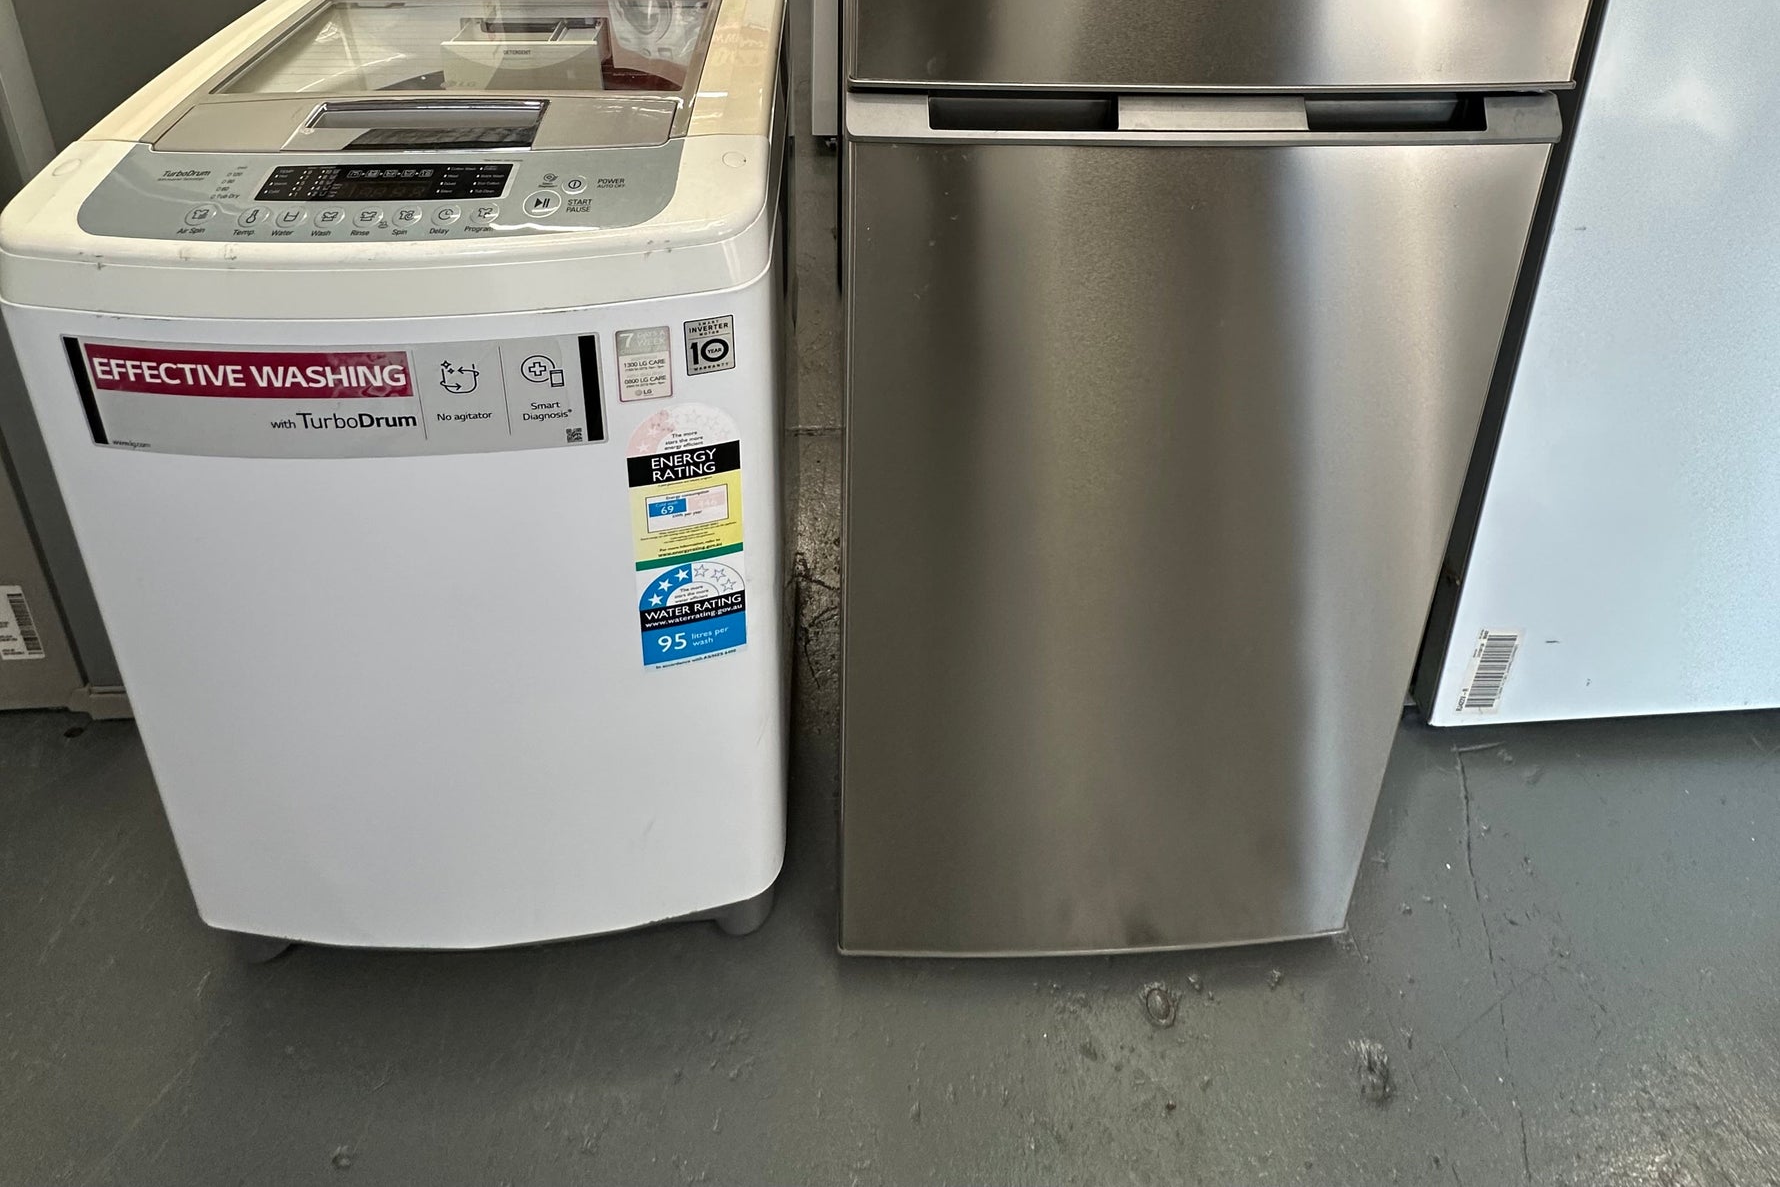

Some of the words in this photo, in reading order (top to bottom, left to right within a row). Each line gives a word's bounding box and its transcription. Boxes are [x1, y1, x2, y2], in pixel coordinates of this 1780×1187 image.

[163, 170, 211, 178] TurboDrum
[188, 227, 206, 235] Spin
[689, 323, 729, 333] INVERTER
[690, 338, 729, 365] 10
[92, 357, 246, 388] EFFECTIVE
[250, 364, 407, 389] WASHING
[530, 401, 561, 411] Smart
[270, 418, 296, 429] with
[296, 413, 417, 430] TurboDrum
[437, 413, 452, 421] No
[454, 411, 493, 422] agitator
[651, 448, 717, 470] ENERGY
[652, 461, 716, 482] RATING
[660, 505, 674, 515] 69
[645, 605, 691, 621] WATER
[694, 594, 742, 611] RATING
[645, 603, 743, 628] www.waterrating.gov.au
[691, 629, 712, 640] litres
[714, 627, 728, 636] per
[692, 636, 714, 646] wash
[658, 632, 687, 652] 95
